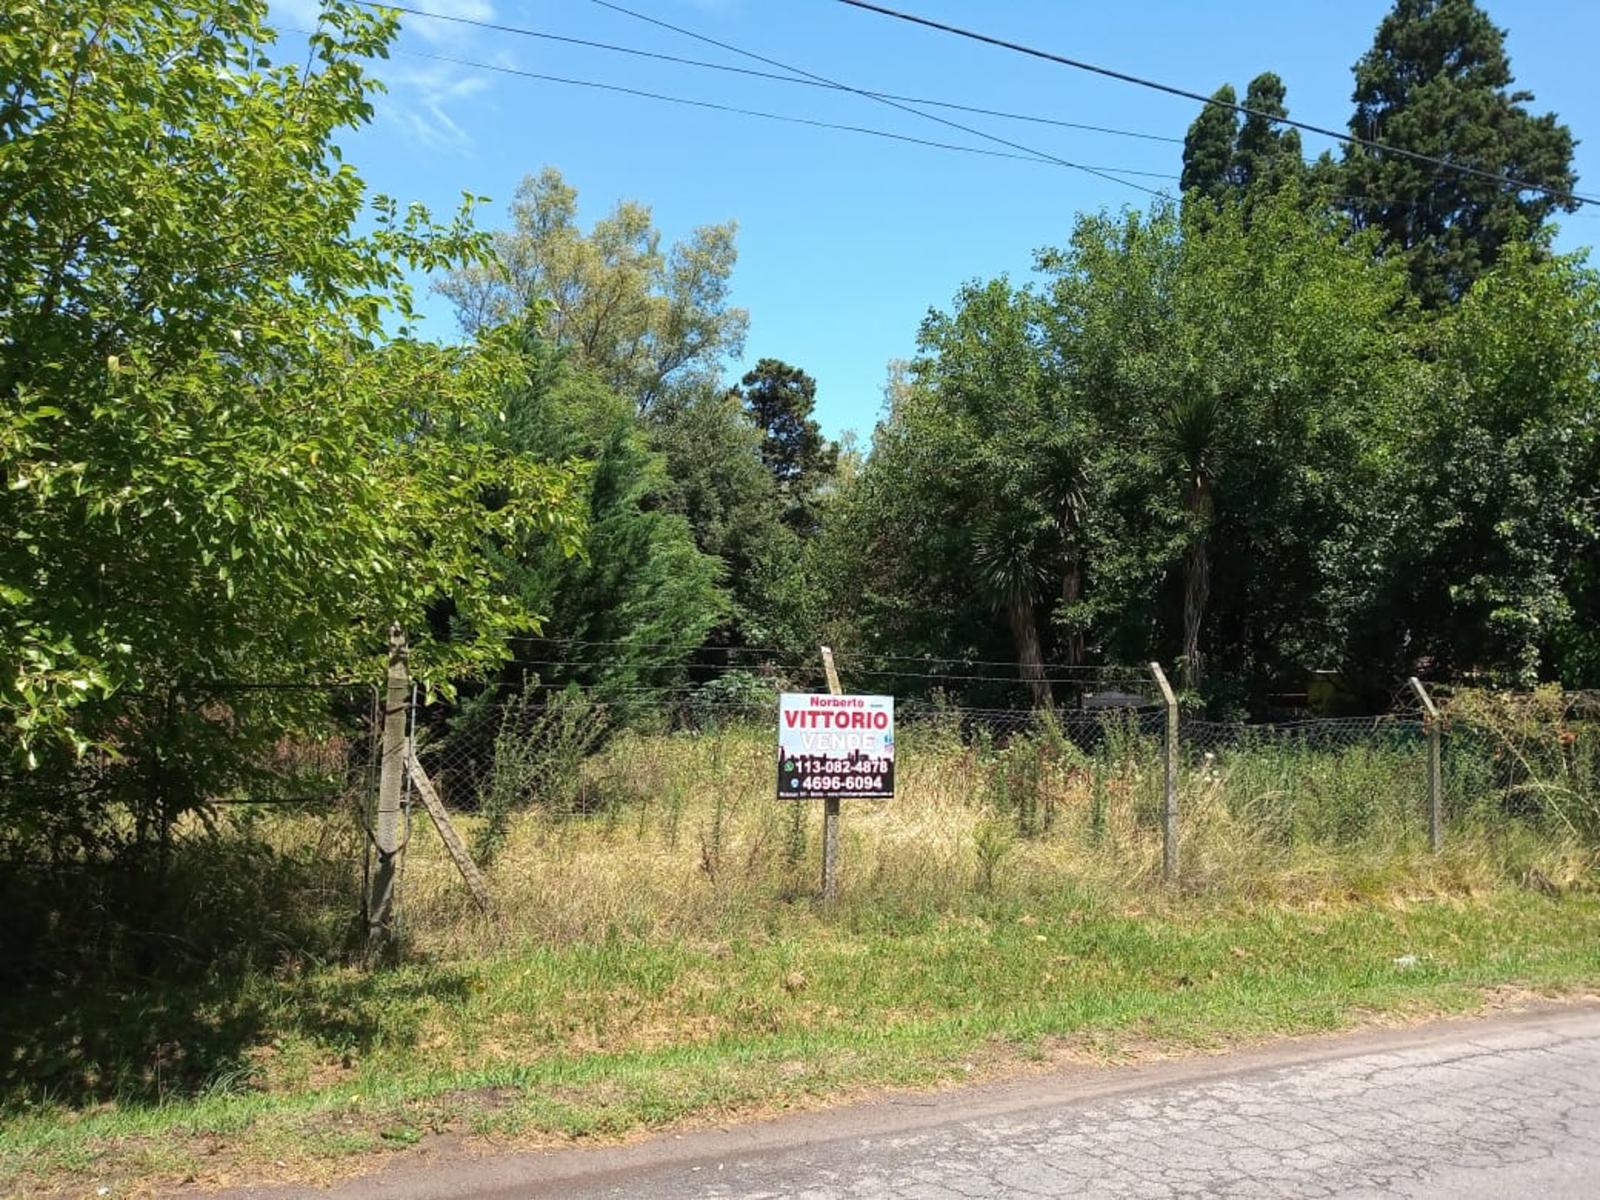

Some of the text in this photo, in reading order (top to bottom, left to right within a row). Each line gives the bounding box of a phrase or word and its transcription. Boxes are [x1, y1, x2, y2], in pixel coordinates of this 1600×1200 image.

[810, 696, 864, 708] Norberto
[784, 710, 888, 729] VITTORIO
[802, 732, 875, 751] VENDE
[795, 760, 888, 773] 113-082-4878
[803, 776, 882, 790] 4696-6094
